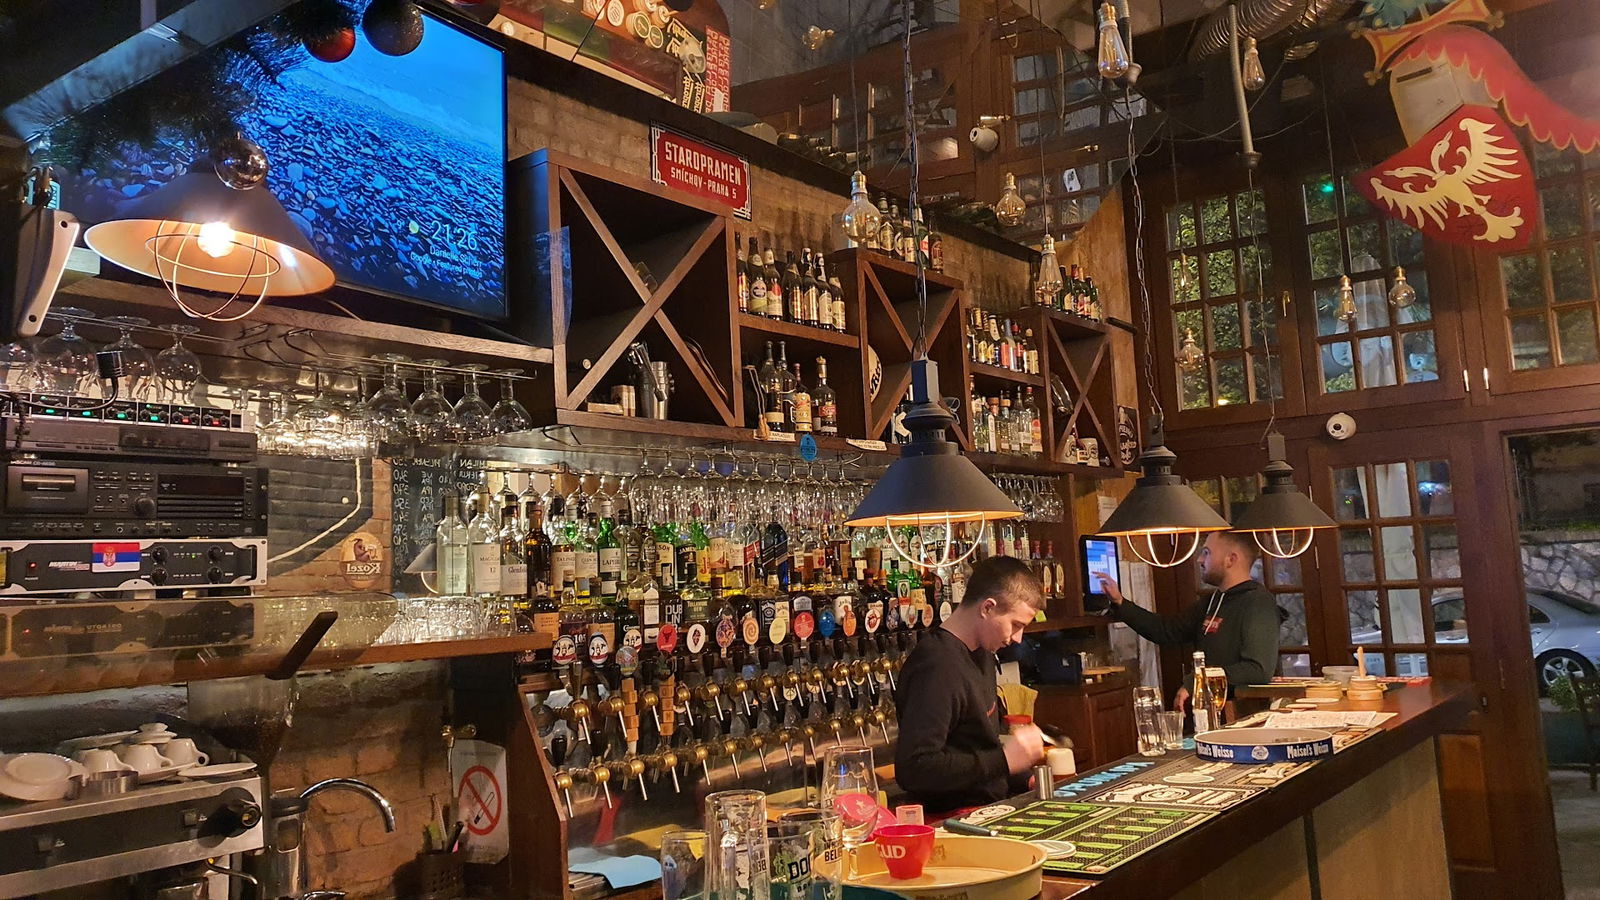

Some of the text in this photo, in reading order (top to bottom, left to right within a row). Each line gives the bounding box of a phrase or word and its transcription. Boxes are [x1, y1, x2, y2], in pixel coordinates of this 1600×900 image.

[665, 141, 741, 186] STAROPRAMEN
[732, 188, 737, 199] 5
[1211, 744, 1234, 759] Weisse
[1286, 743, 1313, 759] Maisel's
